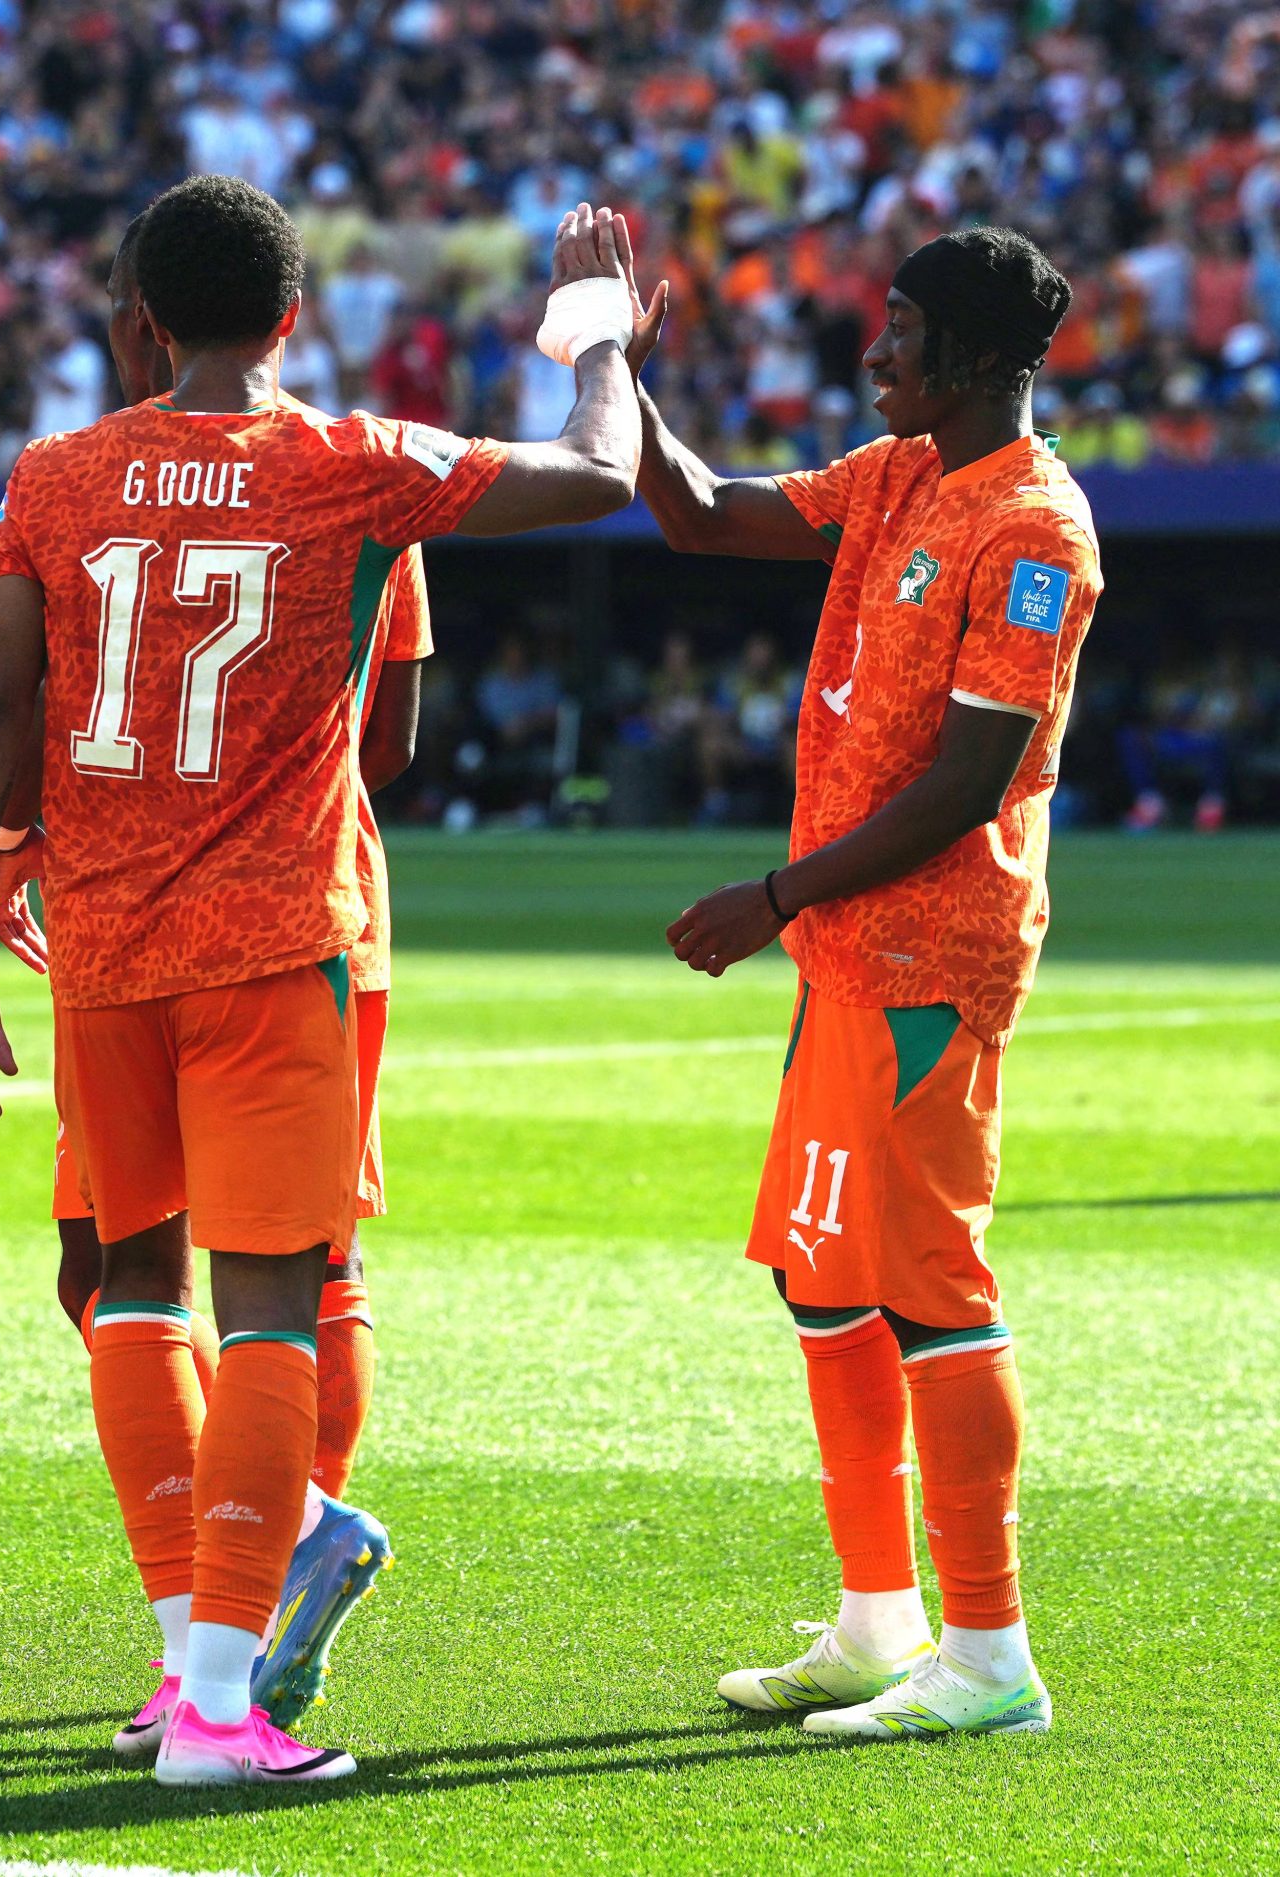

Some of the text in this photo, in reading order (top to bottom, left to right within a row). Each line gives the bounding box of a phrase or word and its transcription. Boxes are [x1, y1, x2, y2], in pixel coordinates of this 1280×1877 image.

[123, 460, 254, 508] G.DOUE
[1022, 589, 1052, 604] Unite For
[1022, 601, 1049, 618] PEACE
[1025, 614, 1041, 623] FIFA
[70, 537, 292, 782] 17
[790, 1140, 850, 1235] 11
